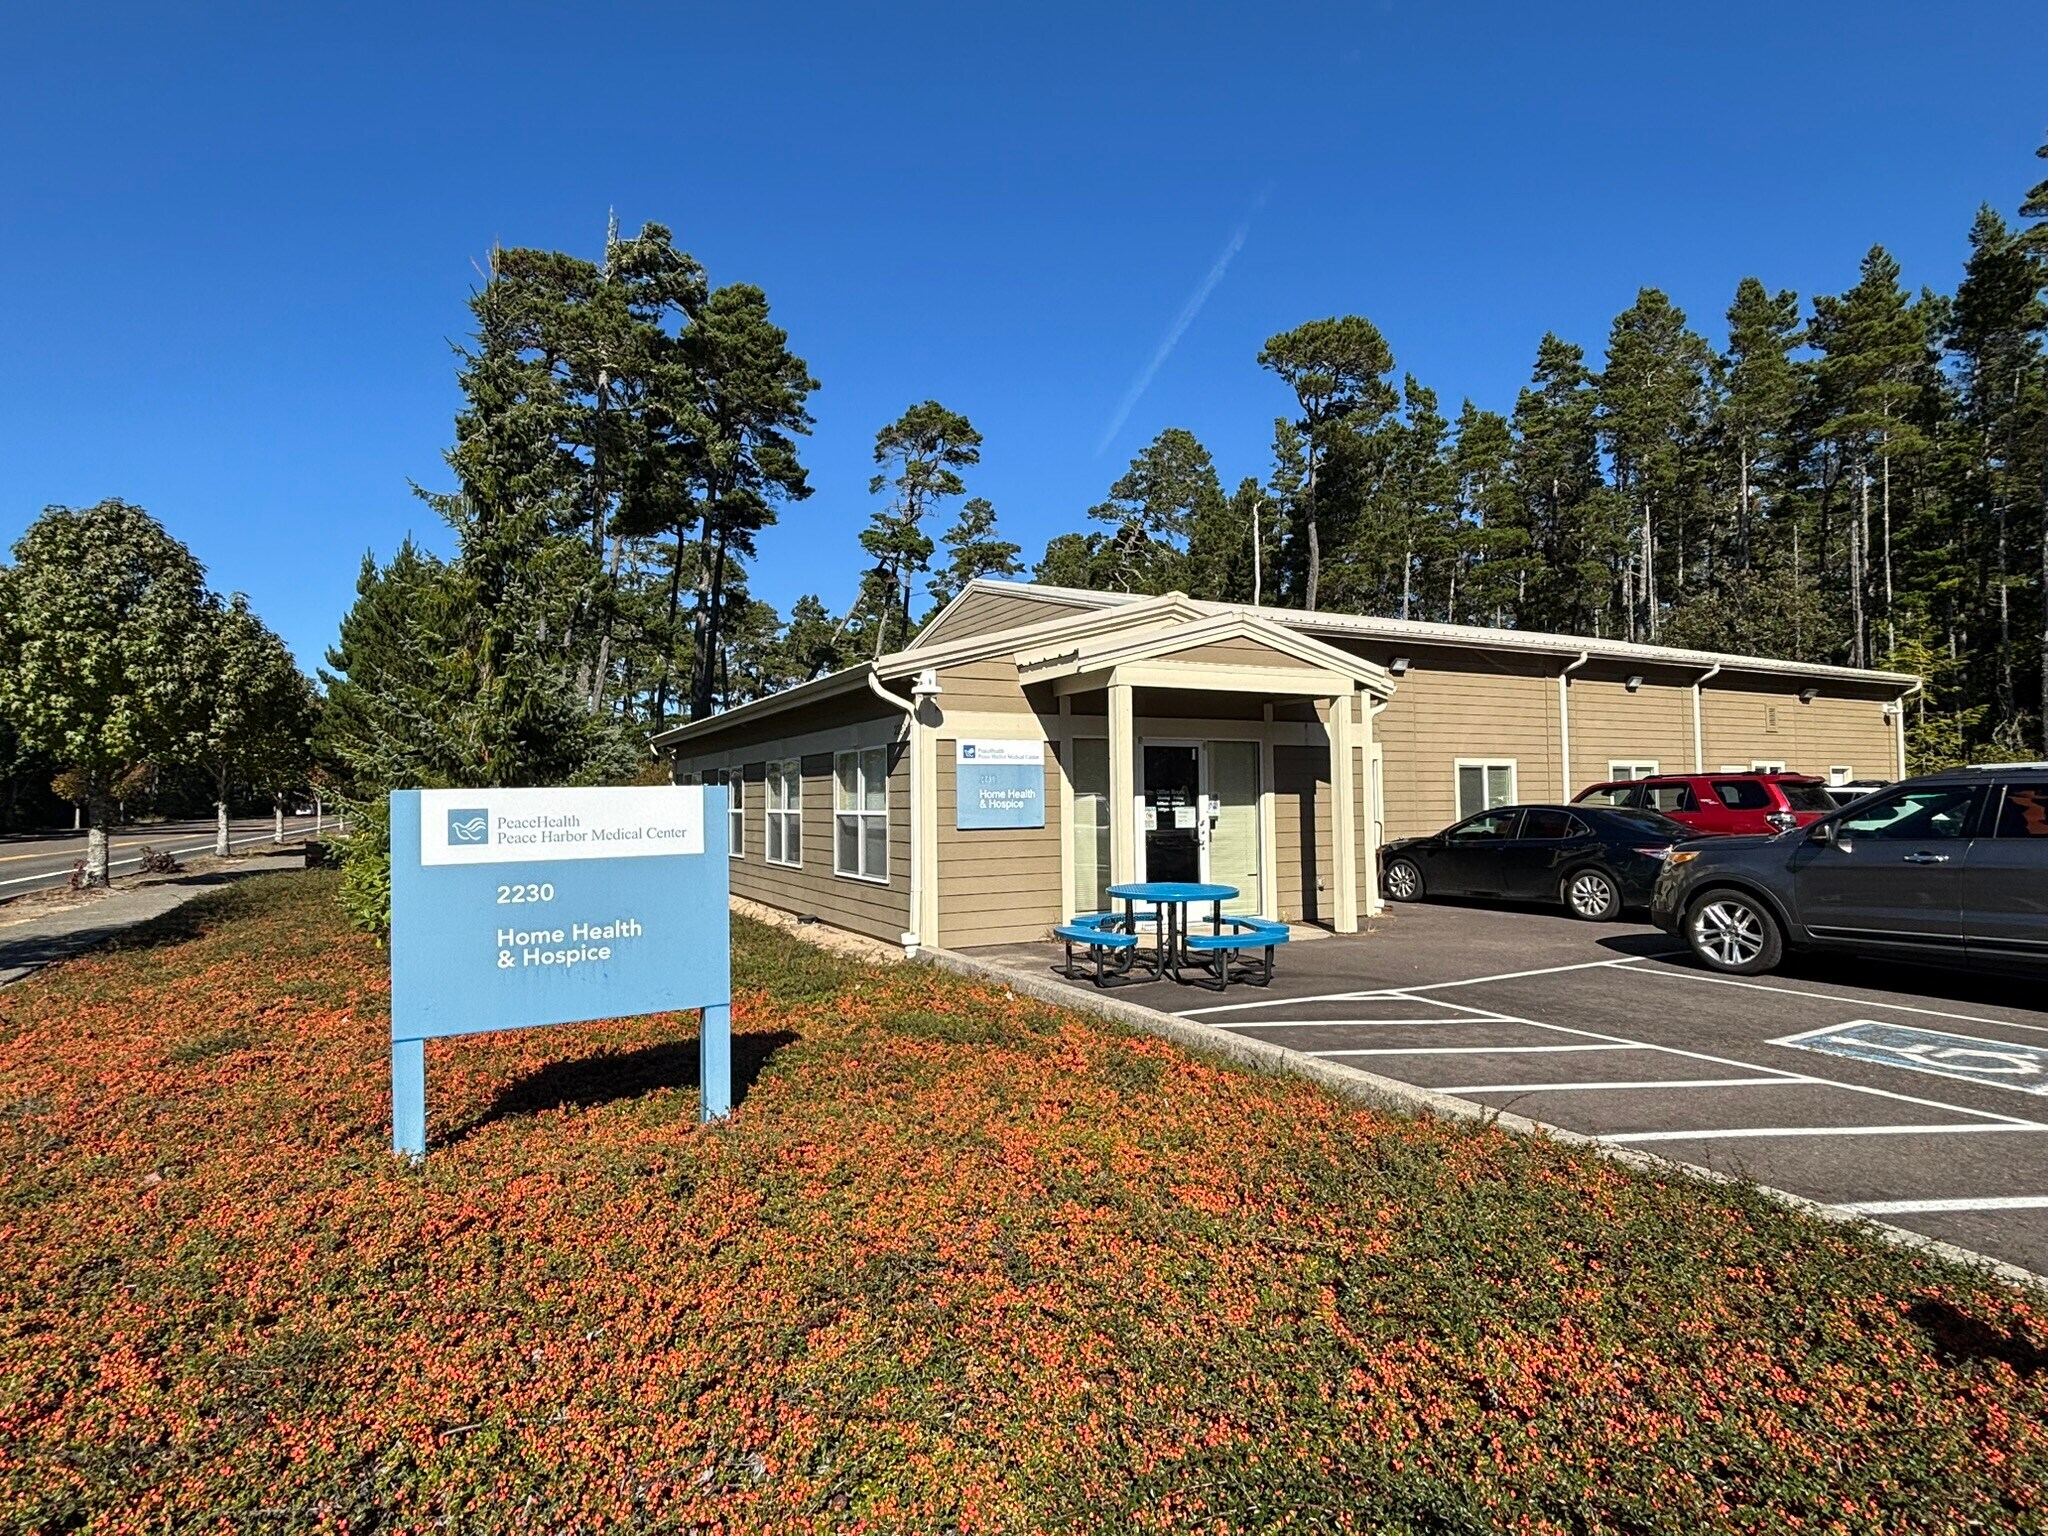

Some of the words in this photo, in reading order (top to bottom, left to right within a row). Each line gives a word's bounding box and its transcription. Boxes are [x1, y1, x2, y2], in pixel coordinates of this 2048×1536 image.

[979, 789, 1005, 799] Home
[1008, 789, 1036, 799] Health
[979, 799, 987, 809] &
[989, 799, 1024, 810] Hospice
[497, 815, 580, 829] PeaceHealth
[497, 832, 537, 844] Peace
[541, 830, 588, 843] Harbor
[591, 827, 642, 841] Medical
[646, 826, 687, 839] Center
[496, 883, 555, 904] 2230
[497, 928, 565, 947] Home
[572, 918, 642, 942] Health
[497, 949, 516, 969] &
[523, 943, 611, 968] Hospice
